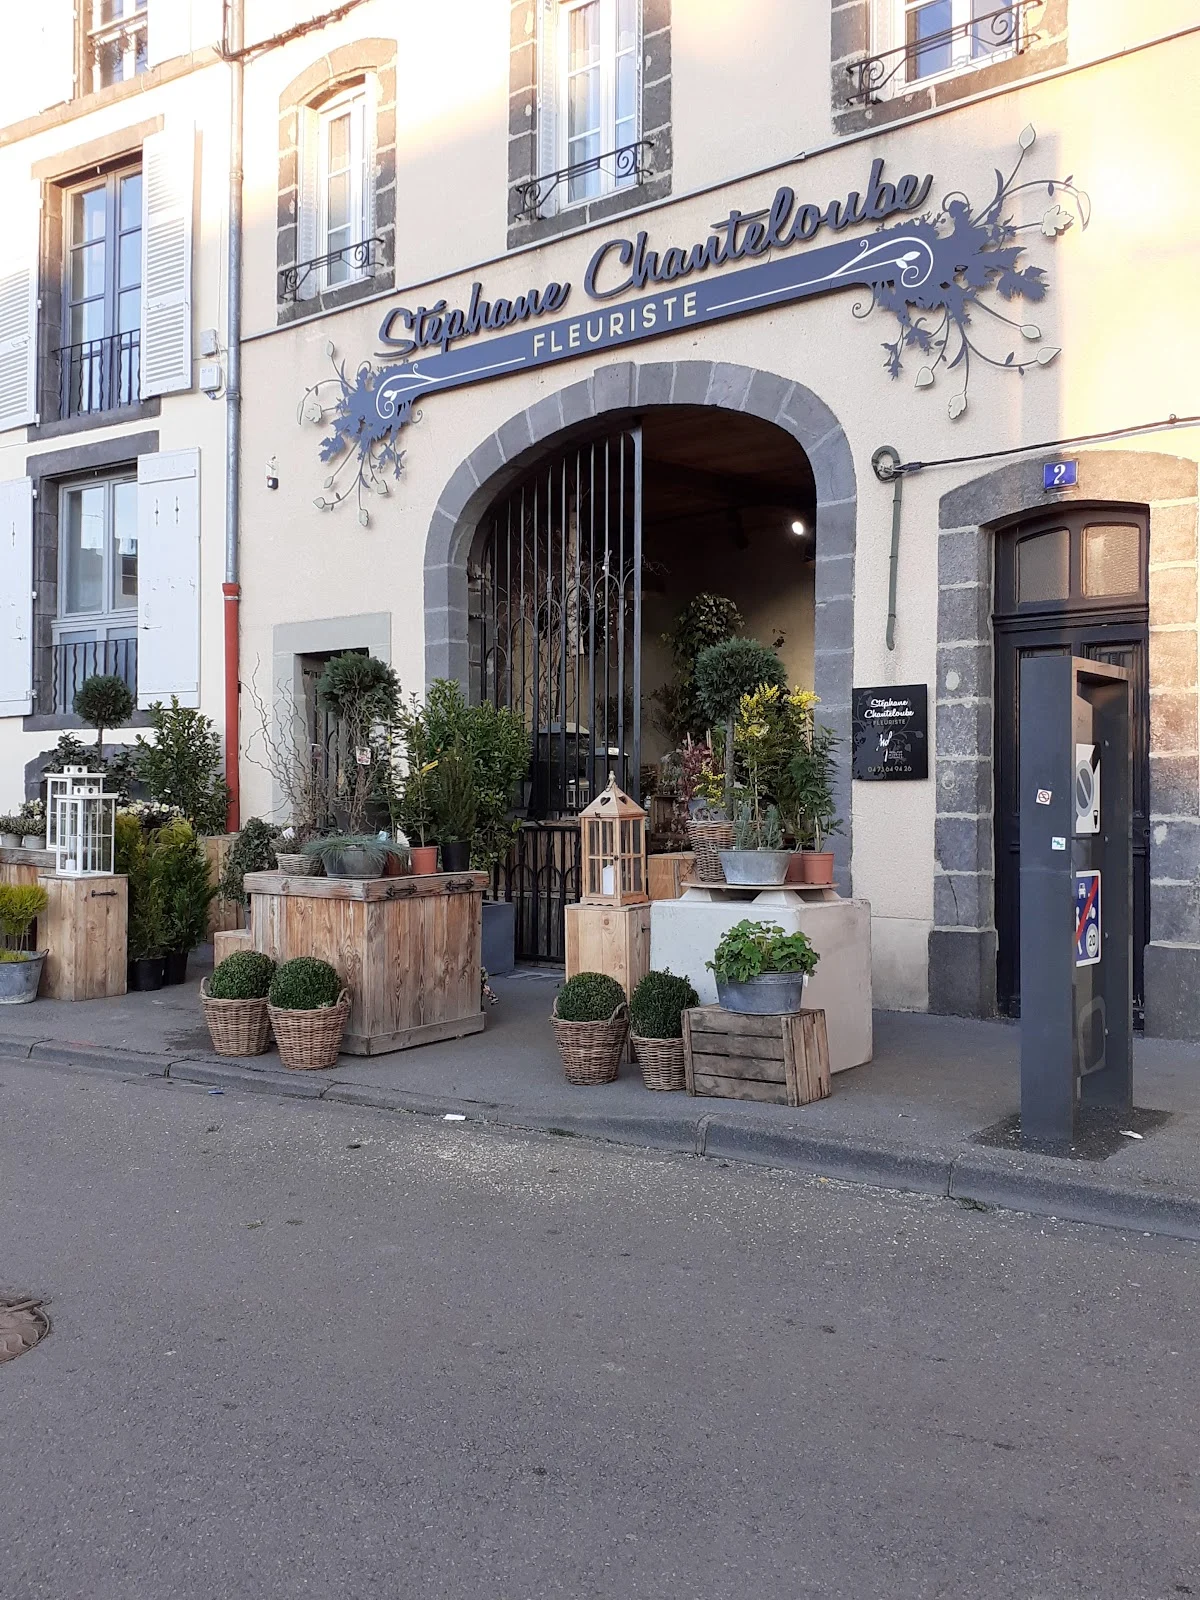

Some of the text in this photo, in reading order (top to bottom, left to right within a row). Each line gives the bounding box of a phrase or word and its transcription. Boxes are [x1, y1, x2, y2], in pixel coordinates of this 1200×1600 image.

[374, 157, 934, 358] Stéphane Chanteloube
[533, 291, 698, 357] FLEURISTE
[1053, 464, 1066, 485] 2
[871, 698, 908, 709] Stéphane
[864, 708, 914, 718] Chanteloube
[1088, 934, 1096, 947] 20
